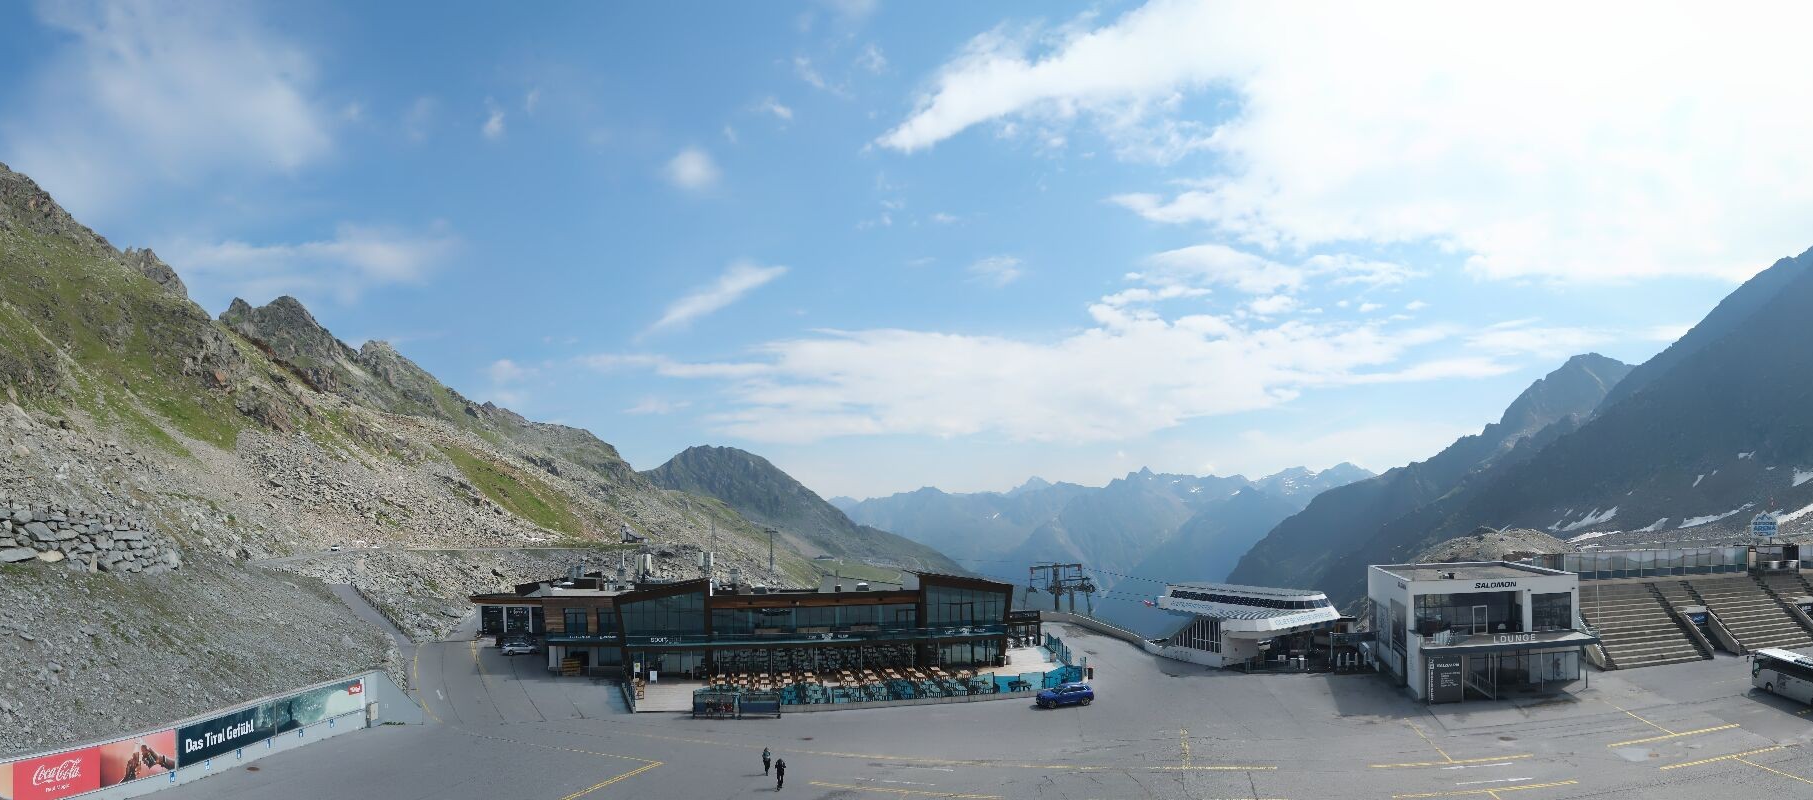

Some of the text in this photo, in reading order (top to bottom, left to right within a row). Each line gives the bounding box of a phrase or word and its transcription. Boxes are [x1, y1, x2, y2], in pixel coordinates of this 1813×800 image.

[1474, 581, 1517, 589] SALOMON
[1493, 633, 1536, 644] LOUNGE
[185, 719, 255, 753] Das Tirol Gefühl
[32, 757, 82, 786] Coca-Cola
